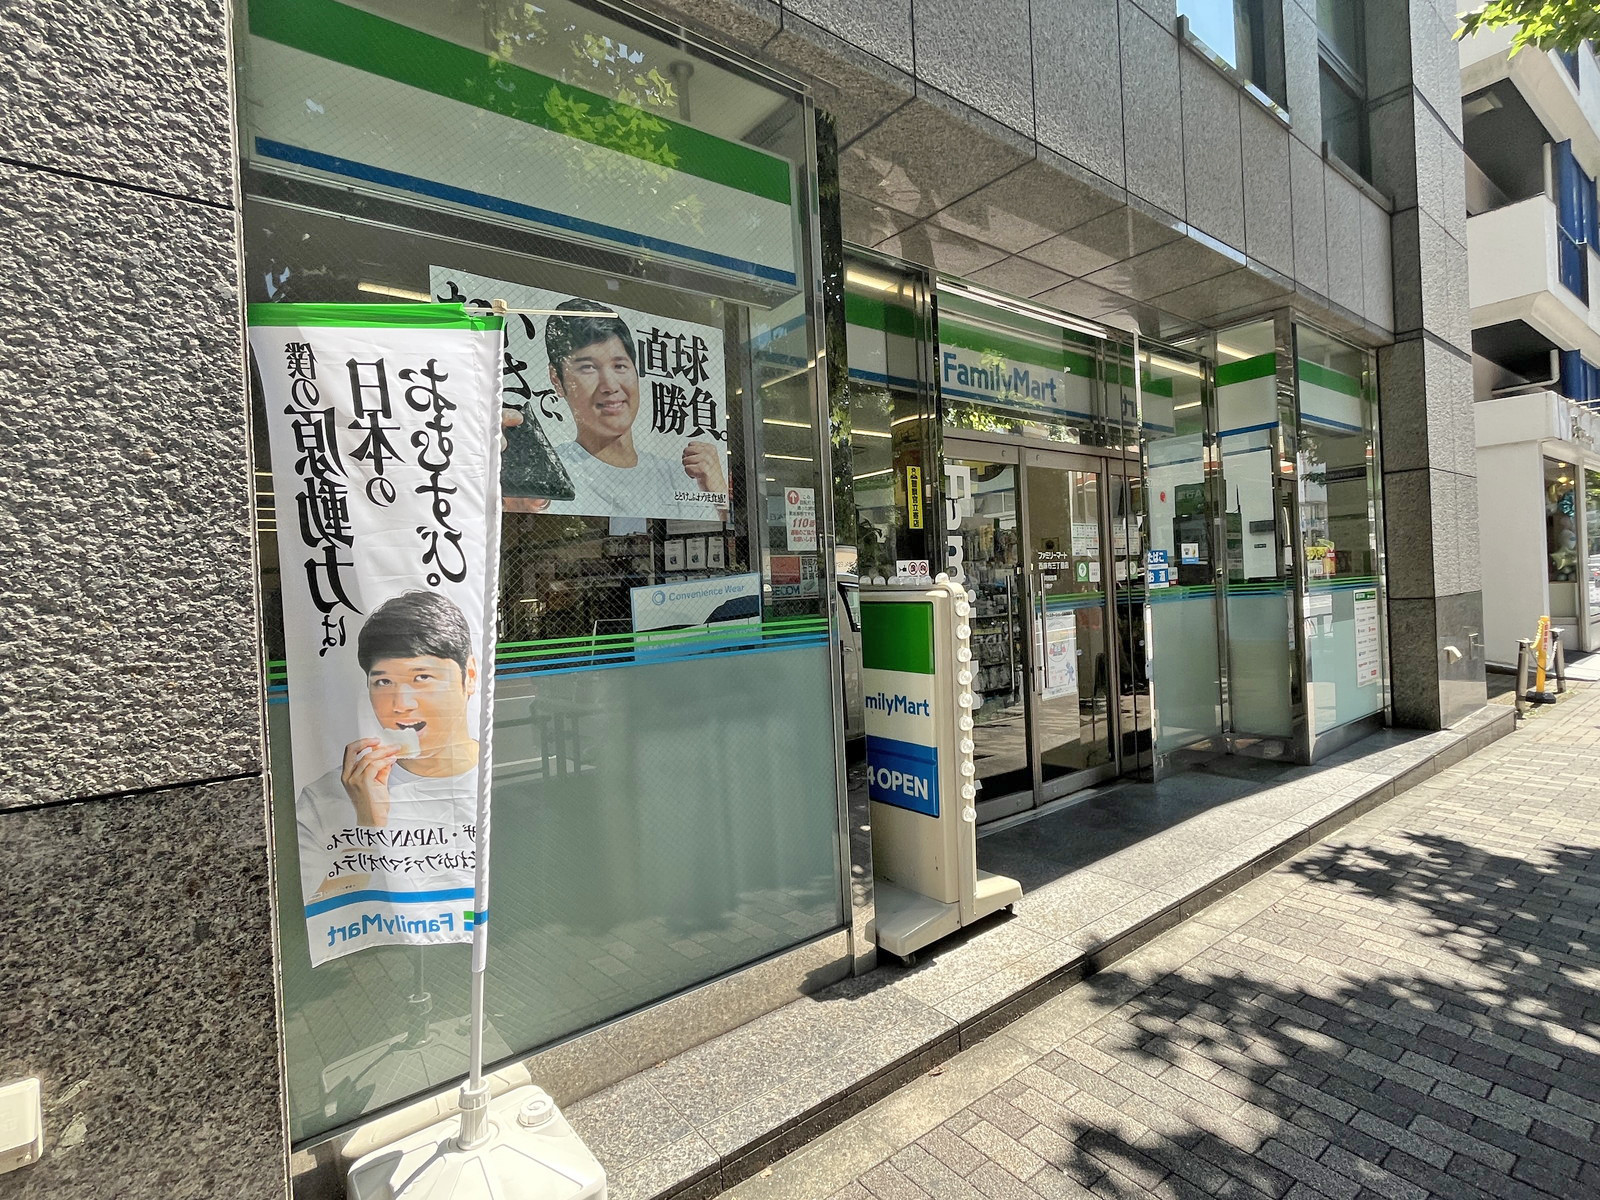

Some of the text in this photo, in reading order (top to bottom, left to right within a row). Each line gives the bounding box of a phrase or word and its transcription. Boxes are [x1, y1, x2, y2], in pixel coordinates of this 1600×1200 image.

[636, 327, 709, 387] 直球
[943, 352, 1057, 403] FamilyMart
[650, 380, 729, 442] 勝負。
[668, 584, 744, 602] Convenience Wear
[865, 692, 930, 717] milyMart
